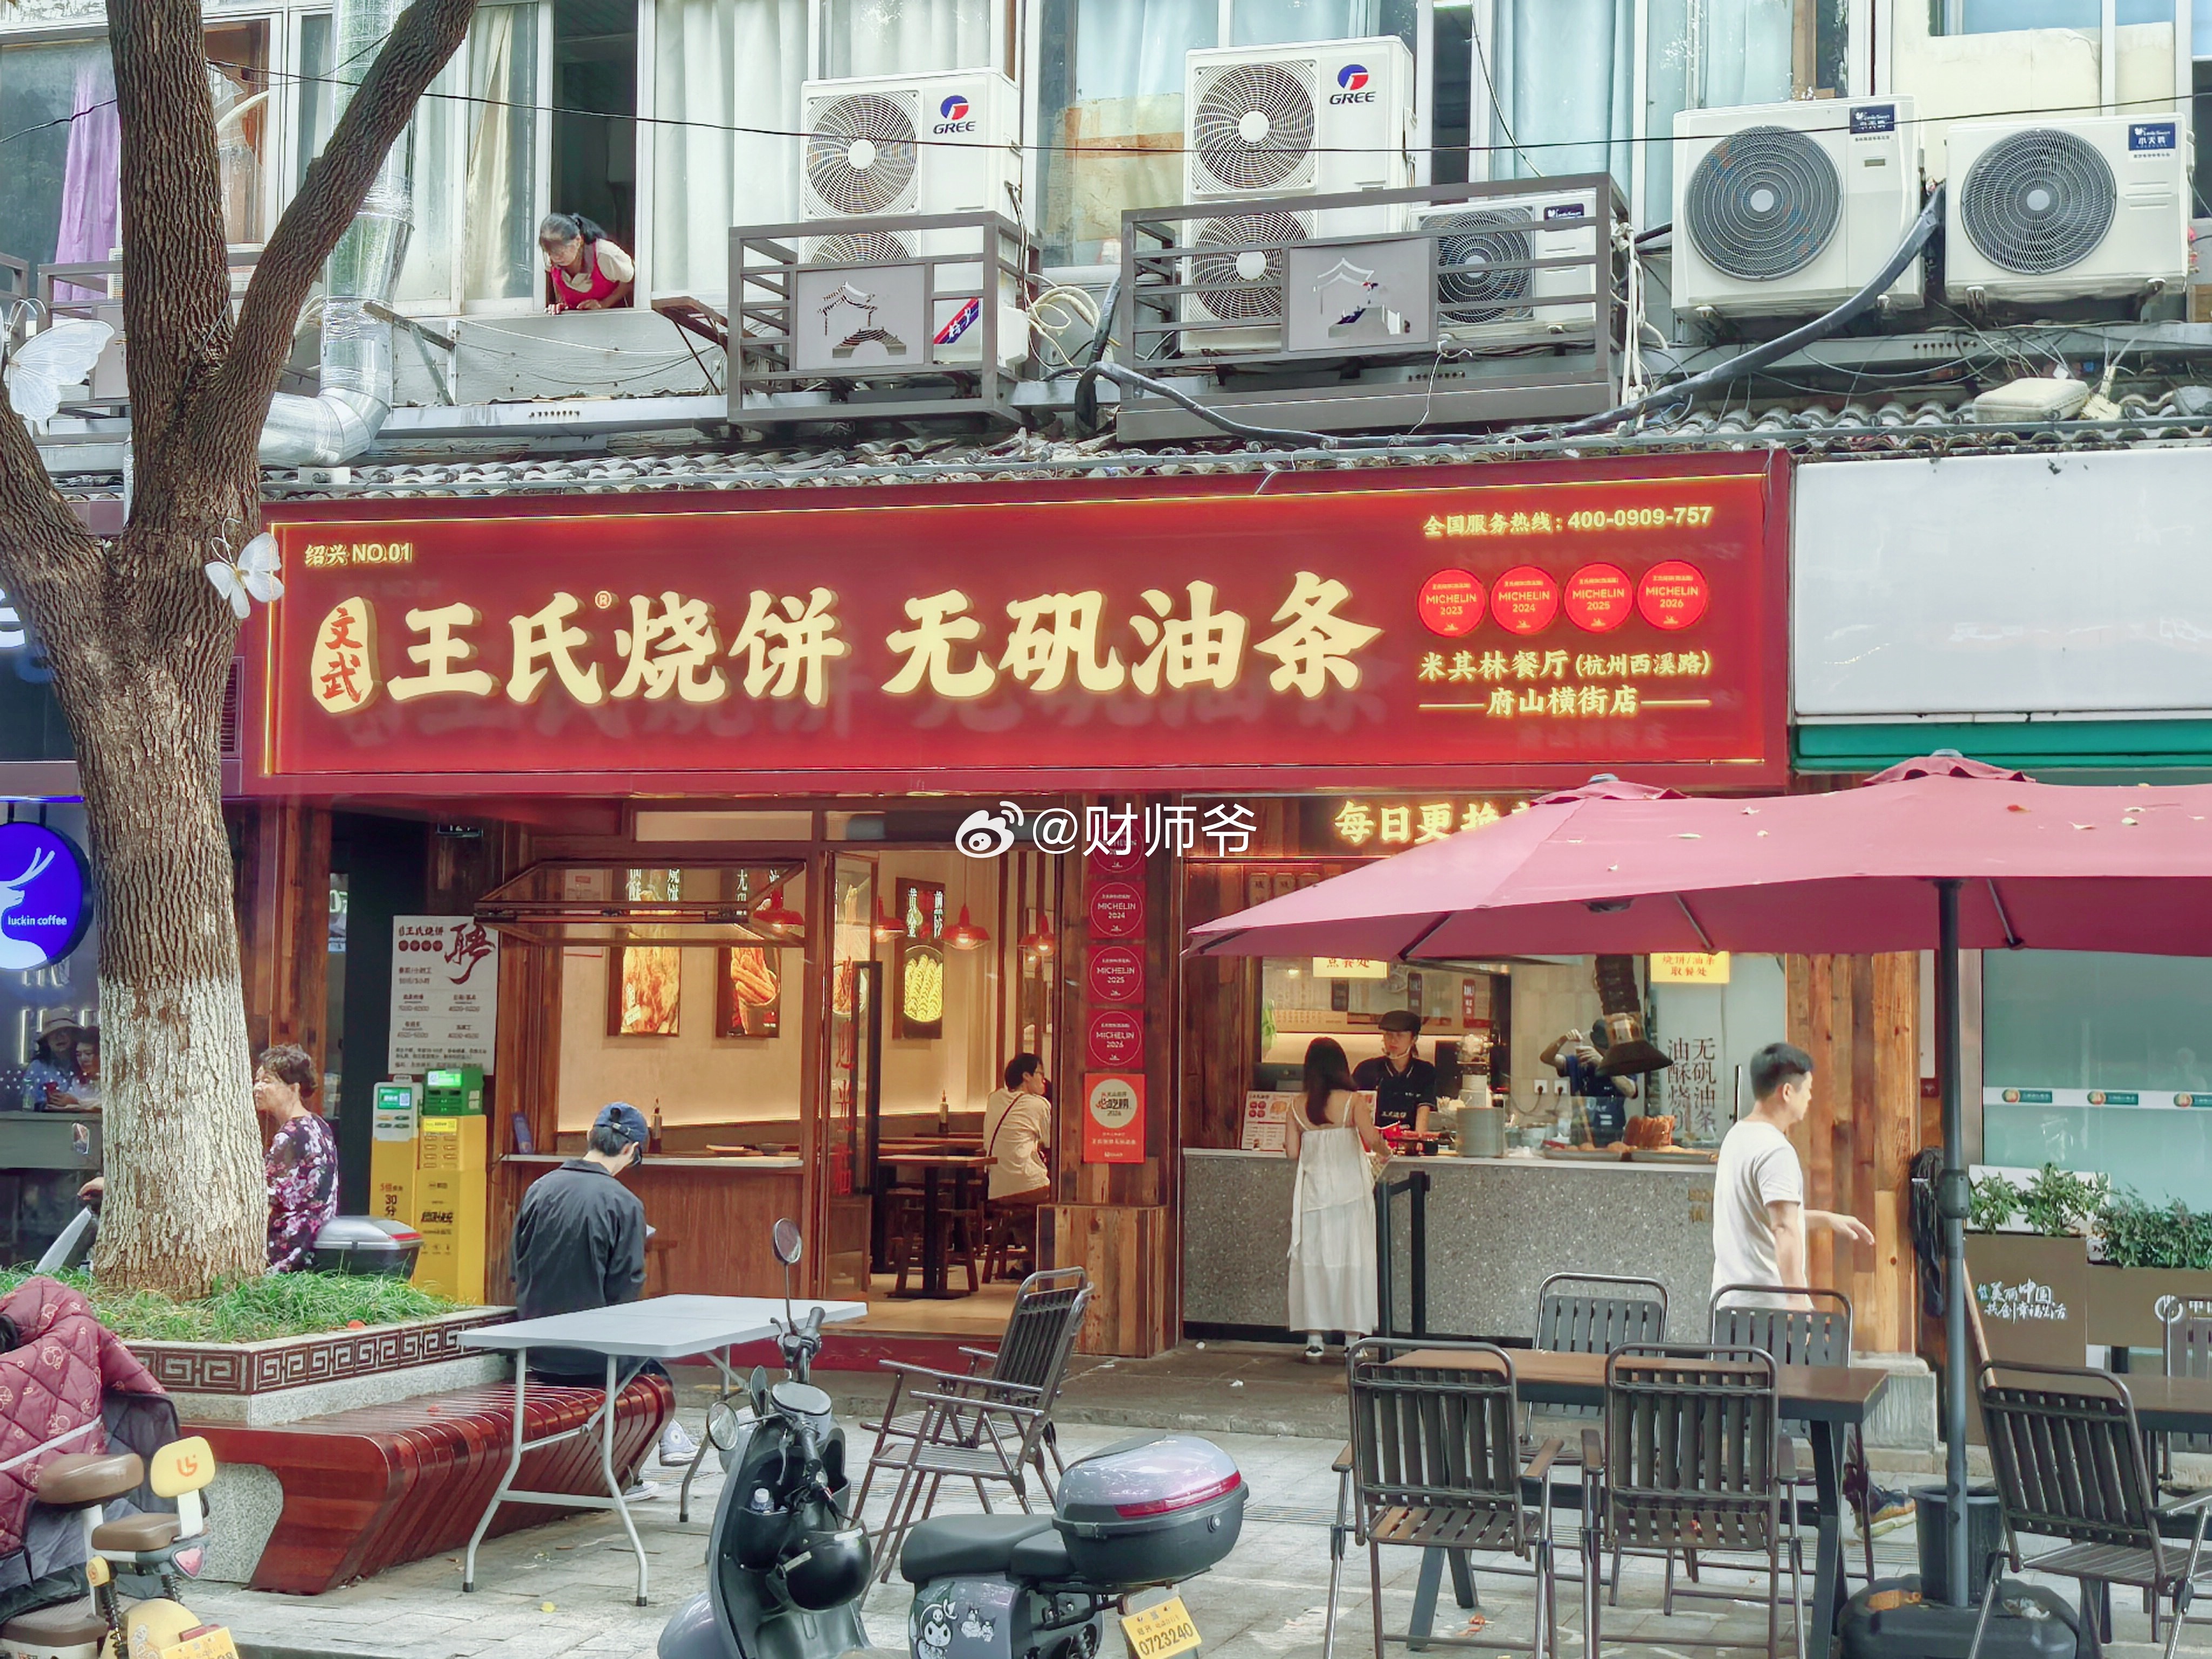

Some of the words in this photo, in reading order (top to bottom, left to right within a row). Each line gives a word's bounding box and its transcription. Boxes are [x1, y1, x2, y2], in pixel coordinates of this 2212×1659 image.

[1330, 91, 1376, 105] GREE
[933, 121, 976, 134] GREE
[304, 545, 348, 566] 绍兴
[352, 543, 413, 564] NO.01
[1499, 591, 1549, 601] MICHELIN
[1573, 589, 1624, 599] MICHELIN
[1646, 586, 1698, 596] MICHELIN
[1426, 594, 1477, 604] MICHELIN
[1660, 599, 1684, 608] 2026
[1440, 606, 1463, 615] 2023
[1513, 604, 1535, 612] 2024
[1587, 602, 1610, 610] 2025
[387, 587, 846, 706] 王氏烧饼
[881, 571, 1384, 698] 无矾油条
[320, 608, 364, 703] 文武
[1486, 686, 1638, 716] 府山横街店
[8, 915, 35, 926] luckin
[37, 915, 67, 926] coffee
[1138, 1622, 1193, 1655] 0723240
